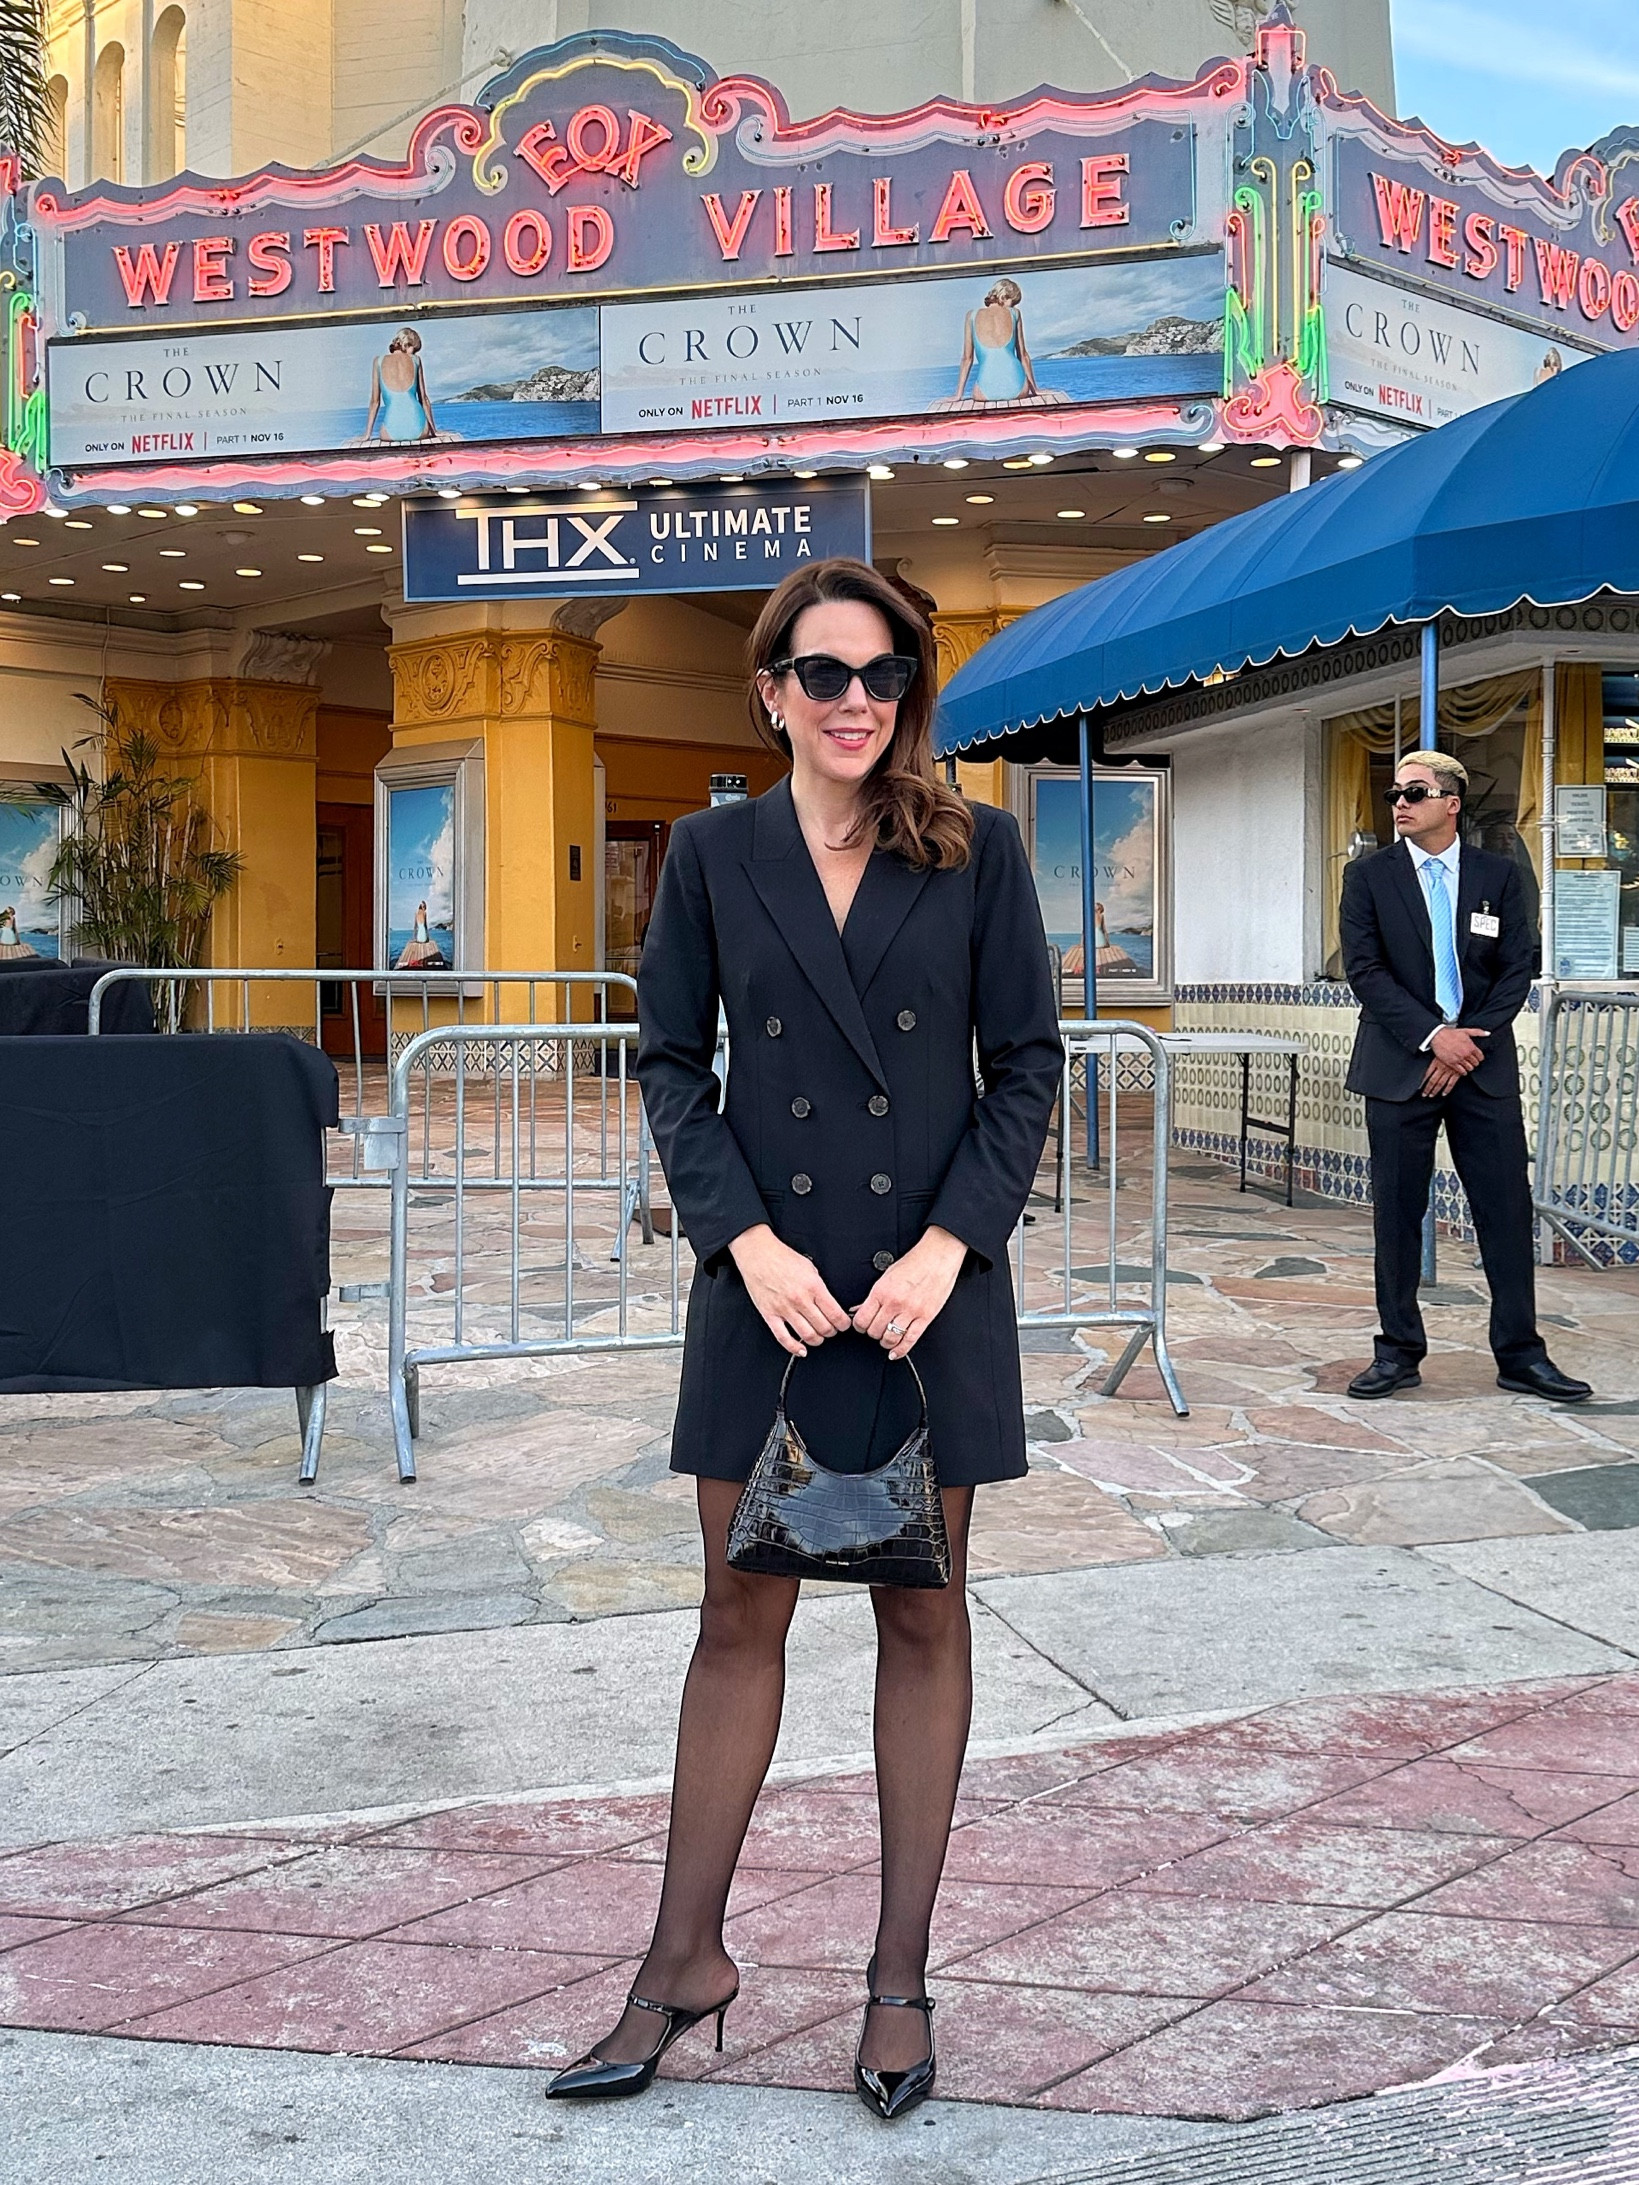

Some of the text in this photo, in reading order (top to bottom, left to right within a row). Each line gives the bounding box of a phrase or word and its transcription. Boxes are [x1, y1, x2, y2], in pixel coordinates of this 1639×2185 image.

[513, 104, 673, 197] FOX
[112, 153, 1131, 308] WESTWOOD VILLAGE
[728, 304, 757, 315] THE
[1401, 299, 1421, 314] THE
[638, 316, 862, 365] CROWN
[1345, 302, 1480, 375] CROWN
[163, 347, 189, 358] THE
[85, 360, 283, 403] CROWN
[679, 368, 821, 386] THE FINAL SEASON
[1423, 375, 1458, 391] SEASON
[638, 408, 665, 419] ONLY
[667, 406, 684, 416] ON
[691, 395, 762, 420] NETFLIX
[787, 397, 814, 408] PART
[826, 395, 850, 405] NOV
[852, 393, 864, 404] 16
[1344, 380, 1363, 393] ONLY
[1363, 386, 1375, 396] ON
[1378, 383, 1423, 416] NETFLIX
[1437, 407, 1453, 419] PART
[121, 407, 248, 423] THE FINAL SEASON
[85, 442, 109, 452] ONLY
[111, 442, 125, 451] ON
[131, 432, 195, 455] NETFLIX
[216, 434, 240, 445] PART
[250, 433, 272, 443] NOV
[274, 432, 284, 441] 16
[650, 505, 812, 540] ULTIMATE
[651, 538, 811, 563] CINEMA
[399, 866, 444, 880] CROWN
[1054, 865, 1135, 879] CRWN
[1474, 915, 1497, 932] SPEC
